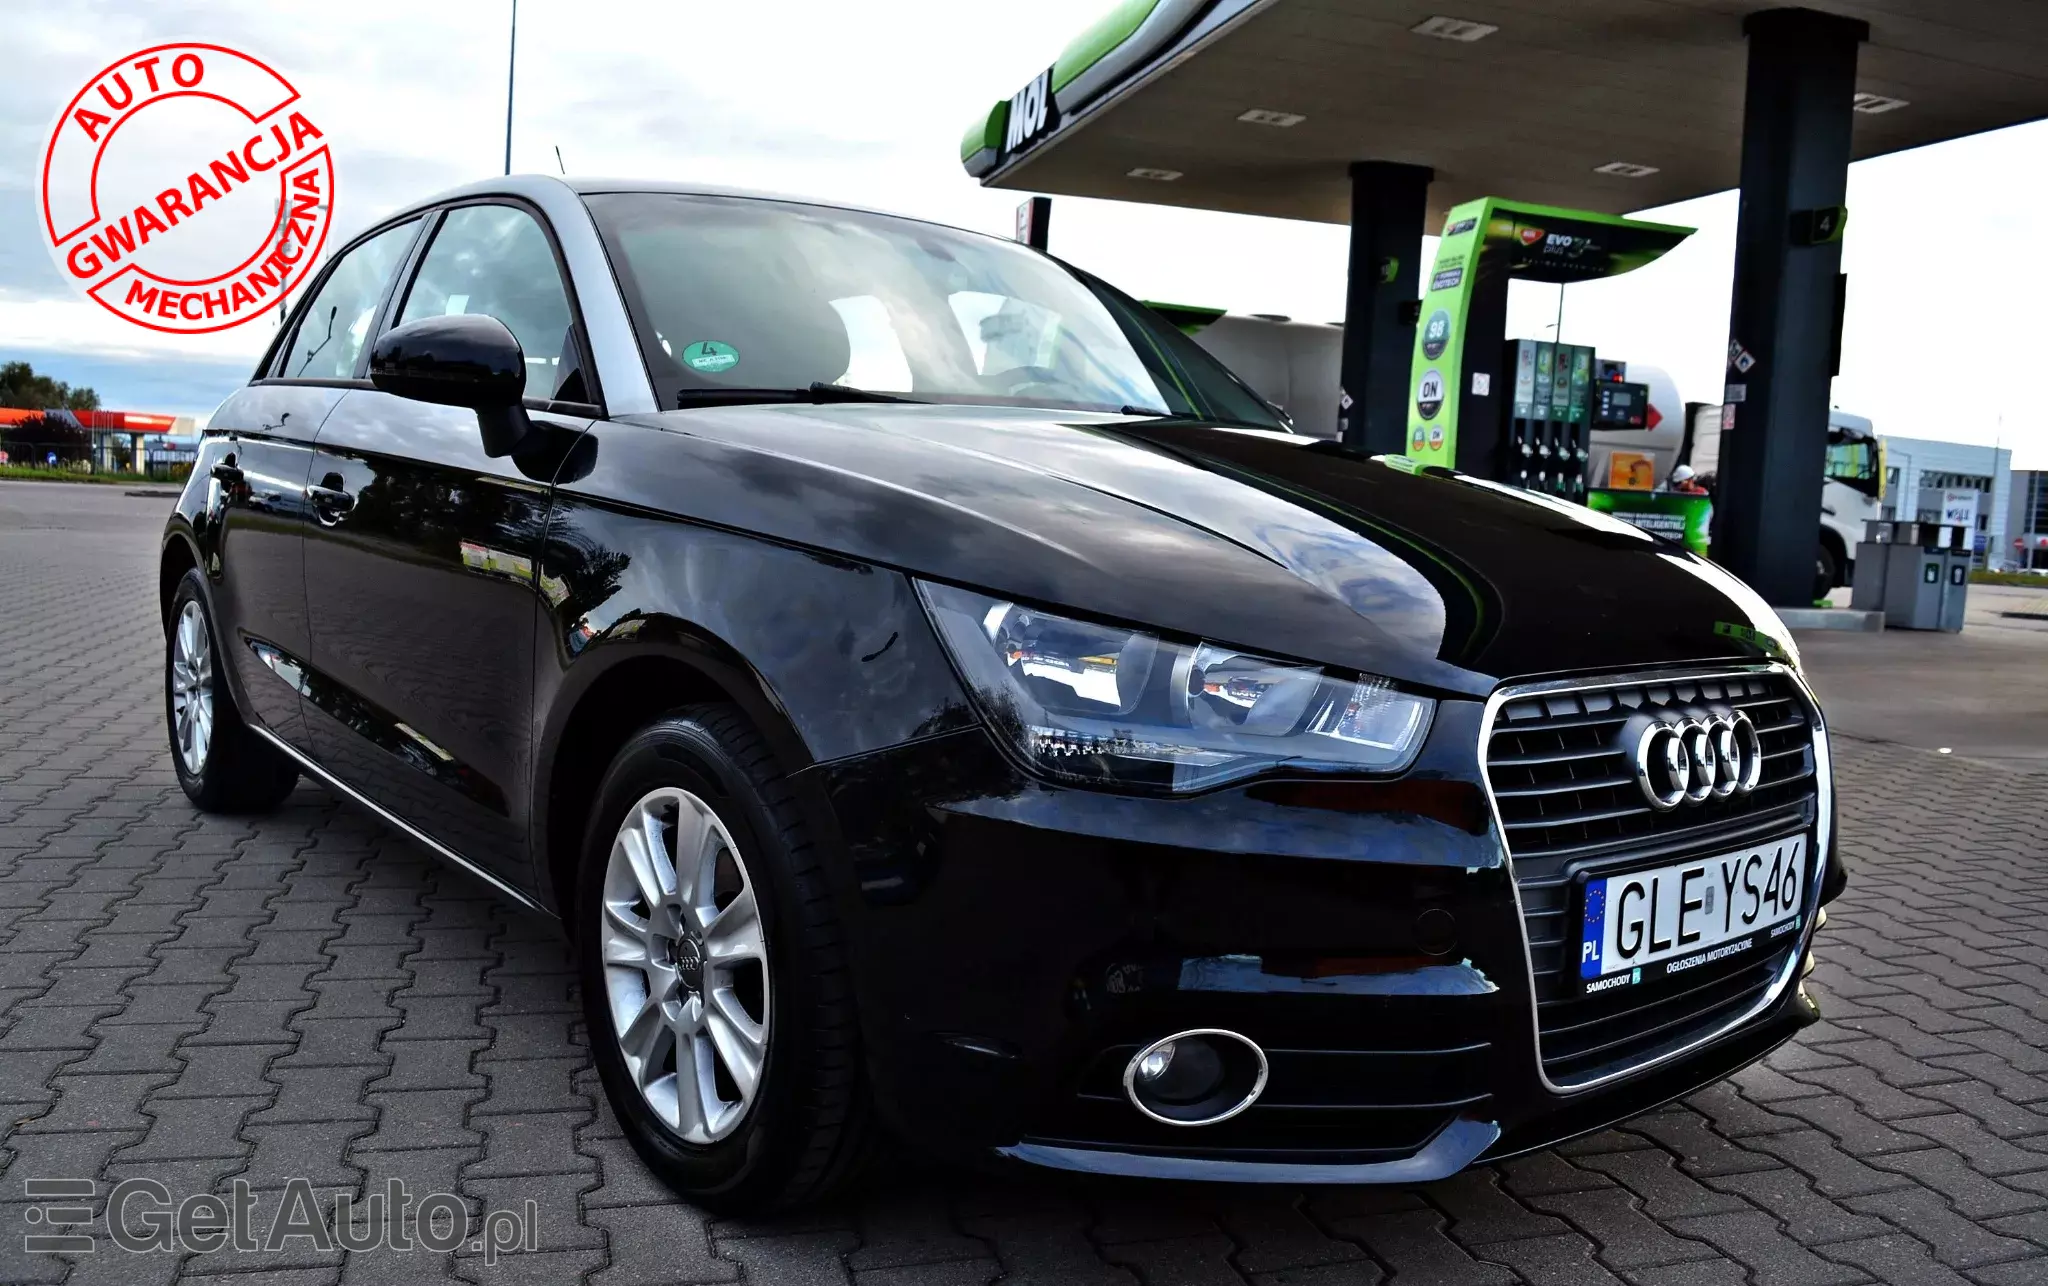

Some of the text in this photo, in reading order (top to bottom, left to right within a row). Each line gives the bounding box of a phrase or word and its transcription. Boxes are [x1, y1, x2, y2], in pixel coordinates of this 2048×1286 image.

[1006, 68, 1049, 153] MOL
[1546, 233, 1572, 247] EVO
[1428, 319, 1445, 339] 98
[1423, 381, 1438, 397] ON
[1616, 842, 1799, 959] GLE YS46
[1582, 940, 1600, 964] PL
[1666, 953, 1706, 974] OGŁOSZENIA
[1586, 973, 1631, 994] SAMOCHODY
